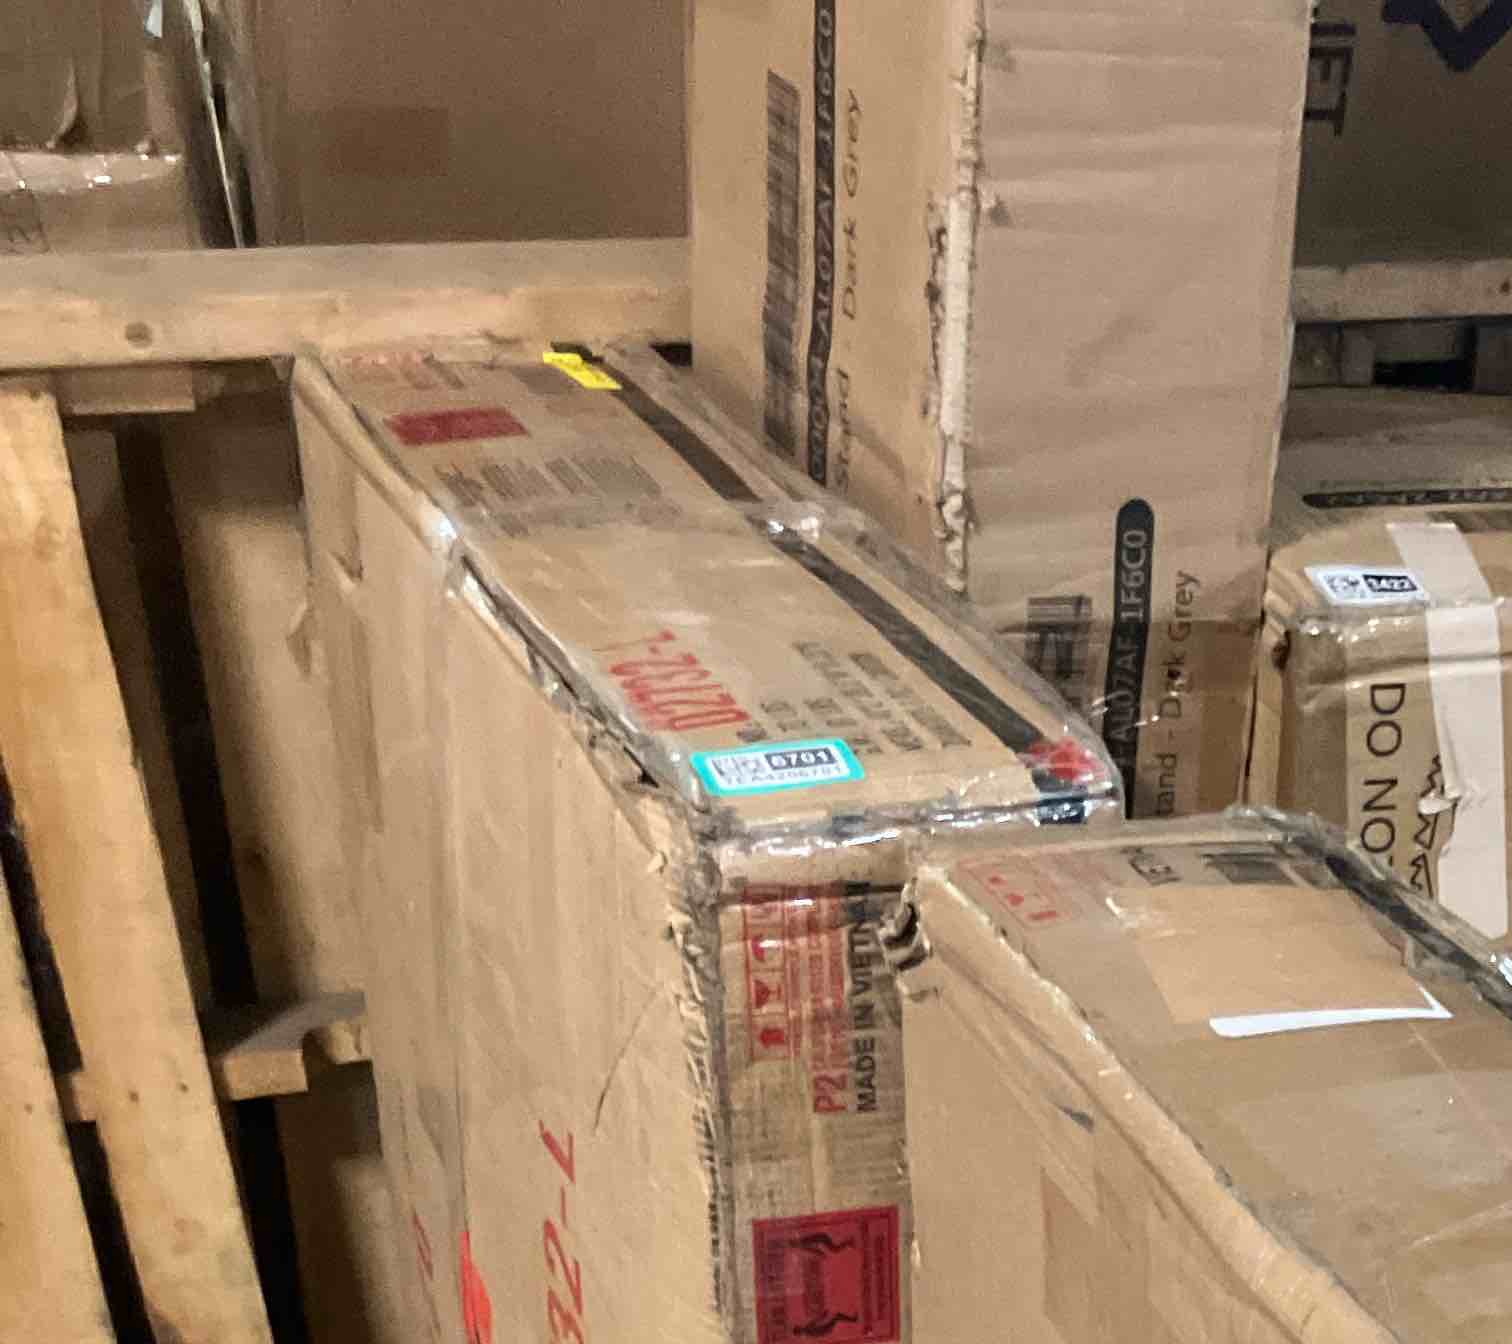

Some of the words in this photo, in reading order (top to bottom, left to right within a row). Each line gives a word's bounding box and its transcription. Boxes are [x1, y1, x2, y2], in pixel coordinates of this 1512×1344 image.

[841, 88, 862, 198] Grey
[840, 217, 858, 321] Dark
[1166, 570, 1200, 642] Grey
[1366, 682, 1407, 758] DO
[1361, 778, 1398, 868] NO
[856, 996, 878, 1032] IN
[814, 1066, 848, 1114] P2
[856, 1035, 878, 1114] MADE
